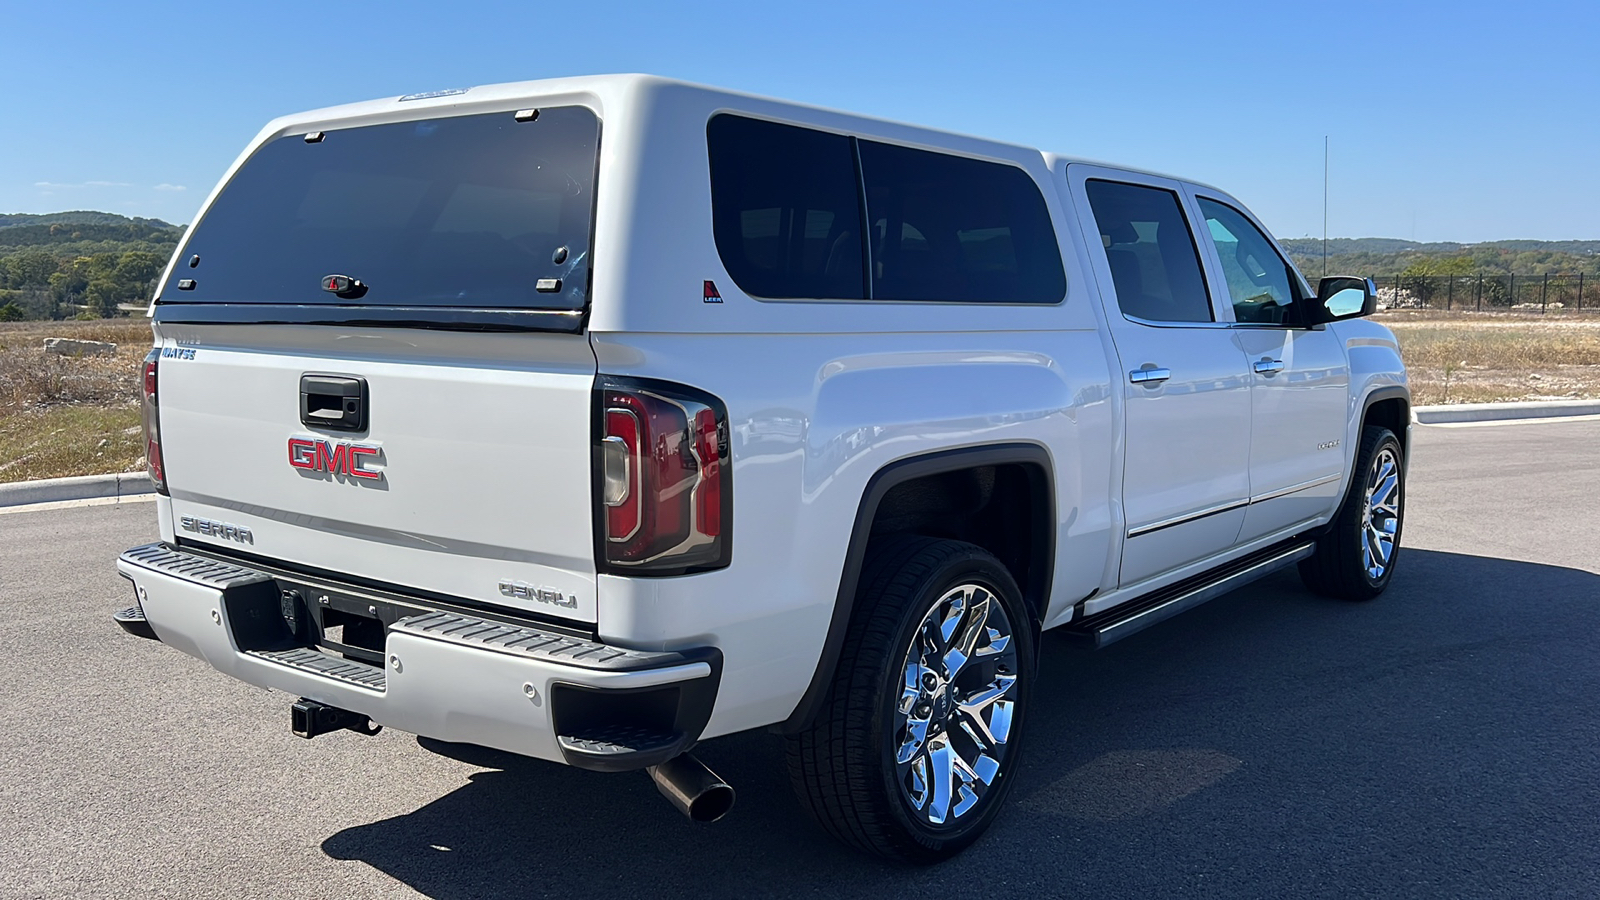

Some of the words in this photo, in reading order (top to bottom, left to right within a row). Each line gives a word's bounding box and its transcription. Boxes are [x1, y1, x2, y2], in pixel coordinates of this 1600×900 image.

[288, 437, 383, 480] GMC
[180, 516, 254, 545] SIERRA
[498, 582, 577, 609] DENALI
